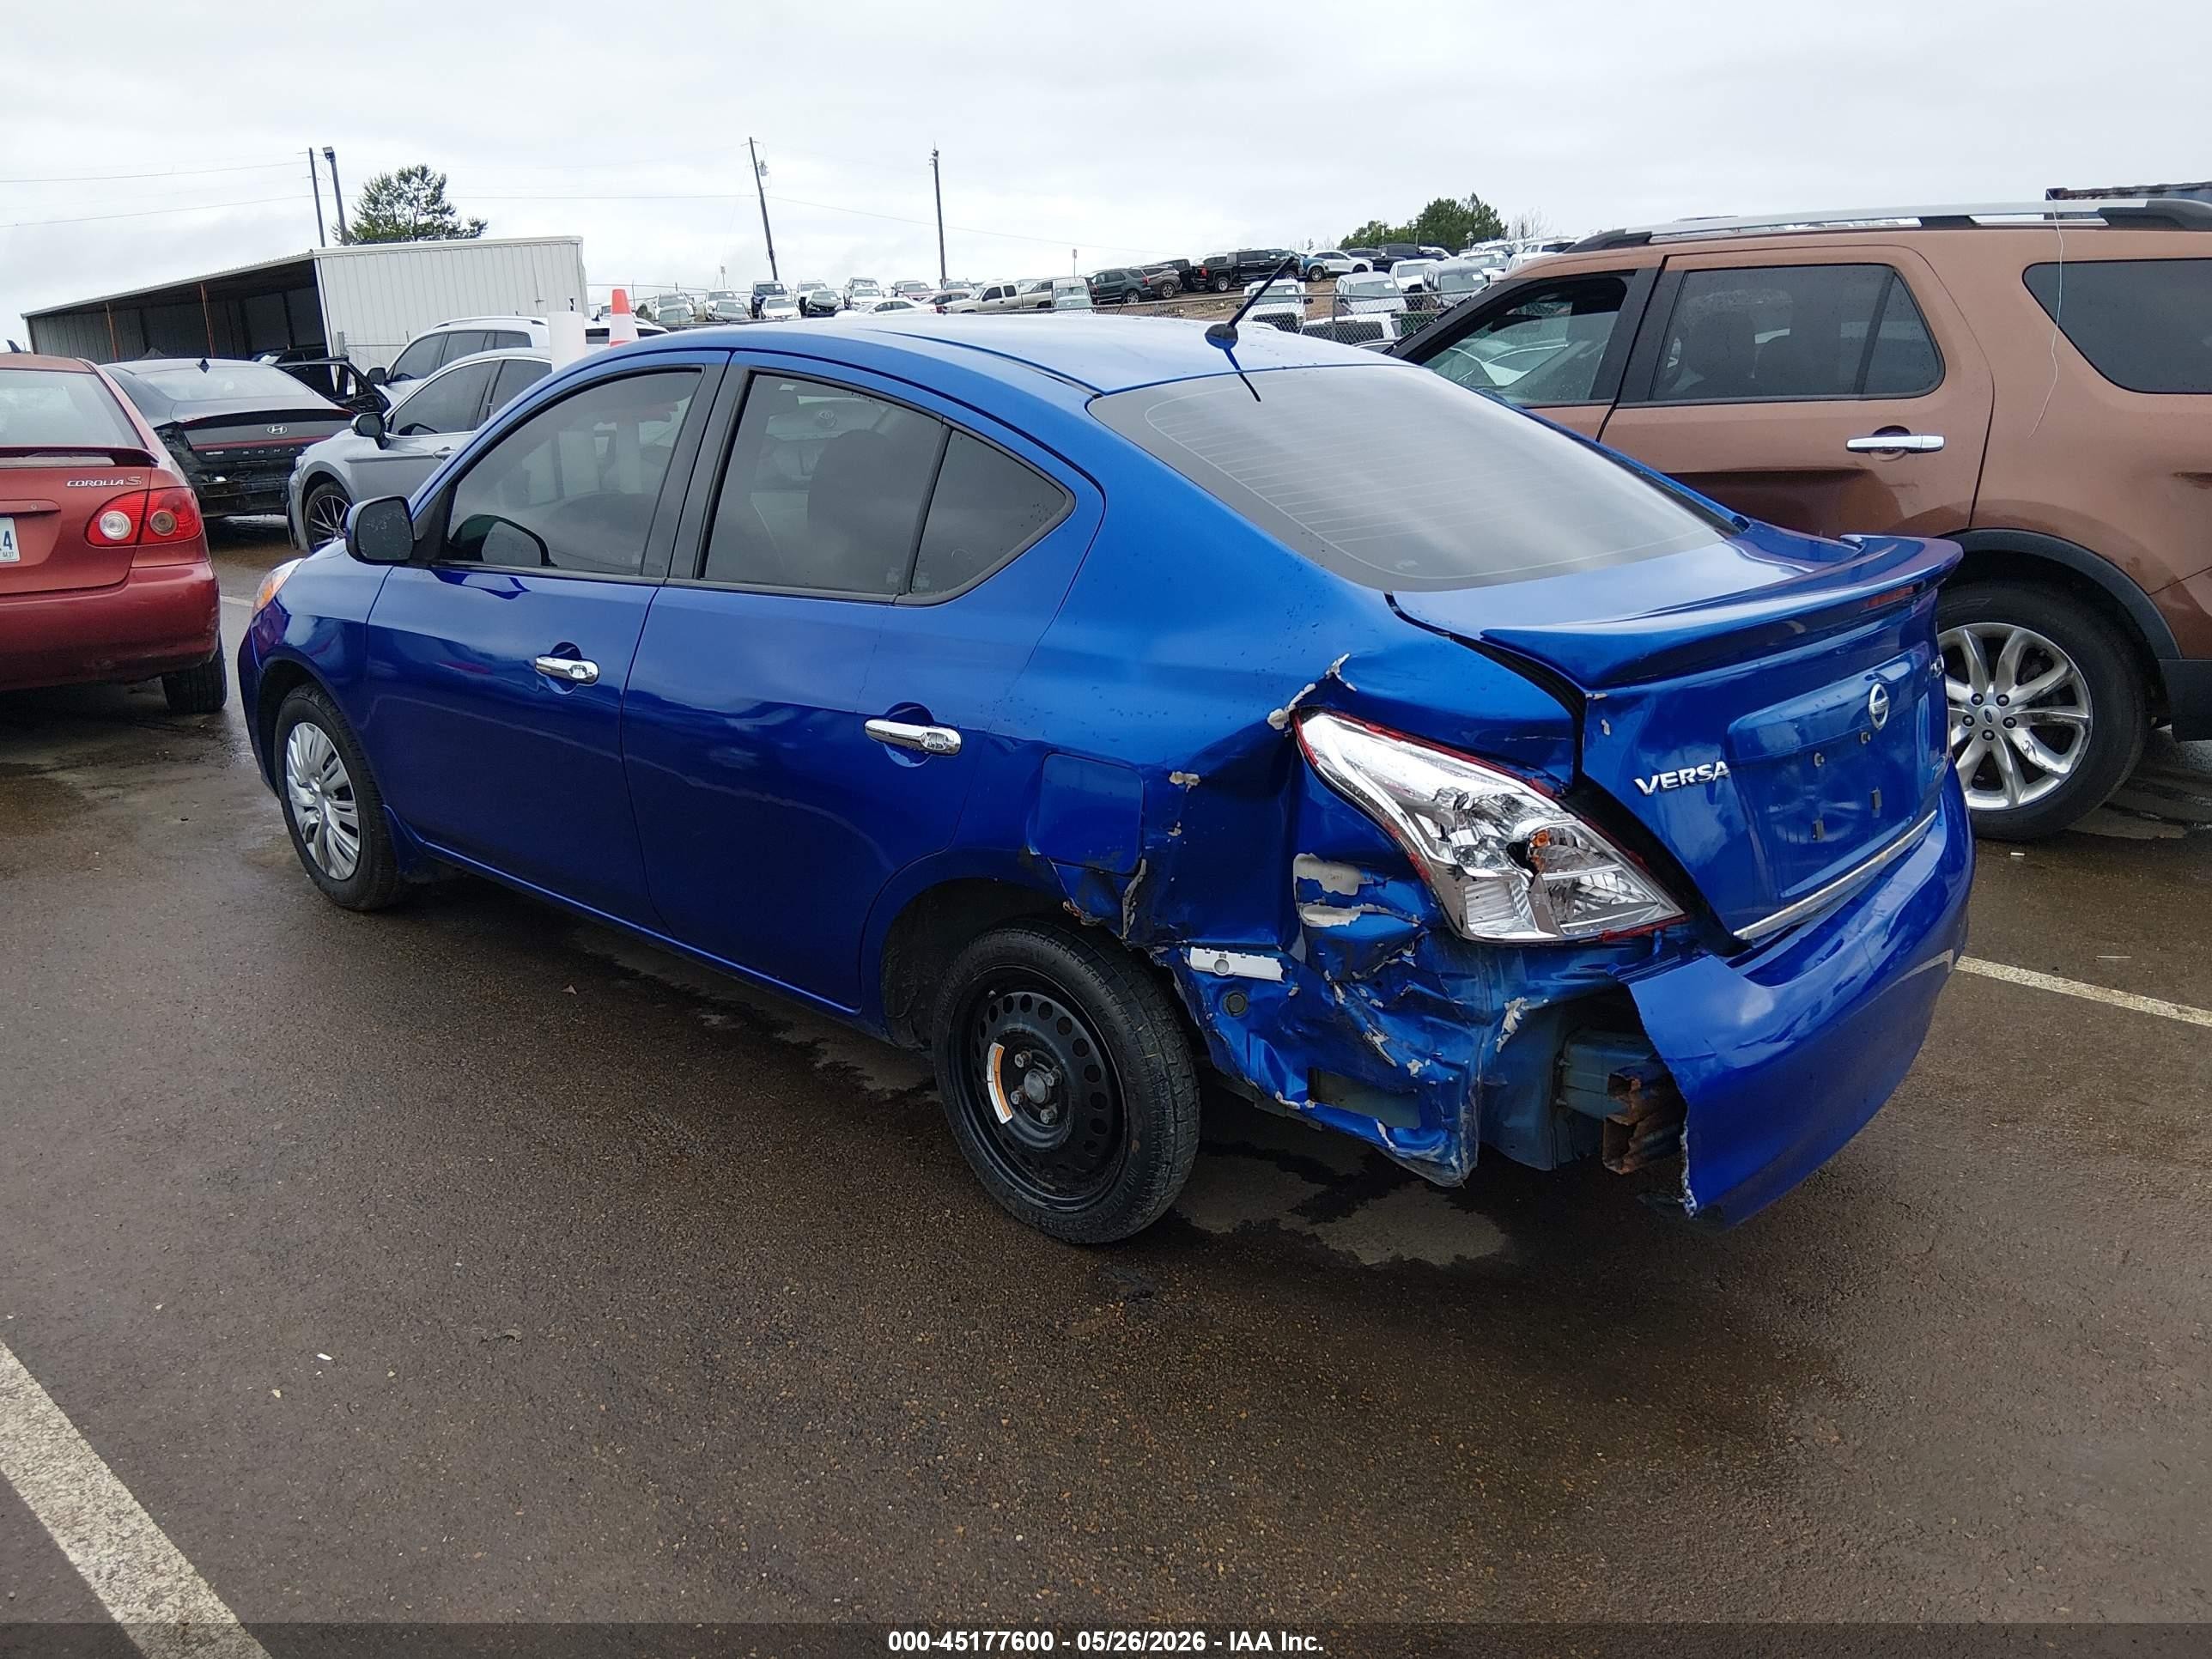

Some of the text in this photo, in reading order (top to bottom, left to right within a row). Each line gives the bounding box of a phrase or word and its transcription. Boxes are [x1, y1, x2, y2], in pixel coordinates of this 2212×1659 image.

[67, 476, 142, 488] COROLLA S
[1632, 760, 1730, 796] VERSA
